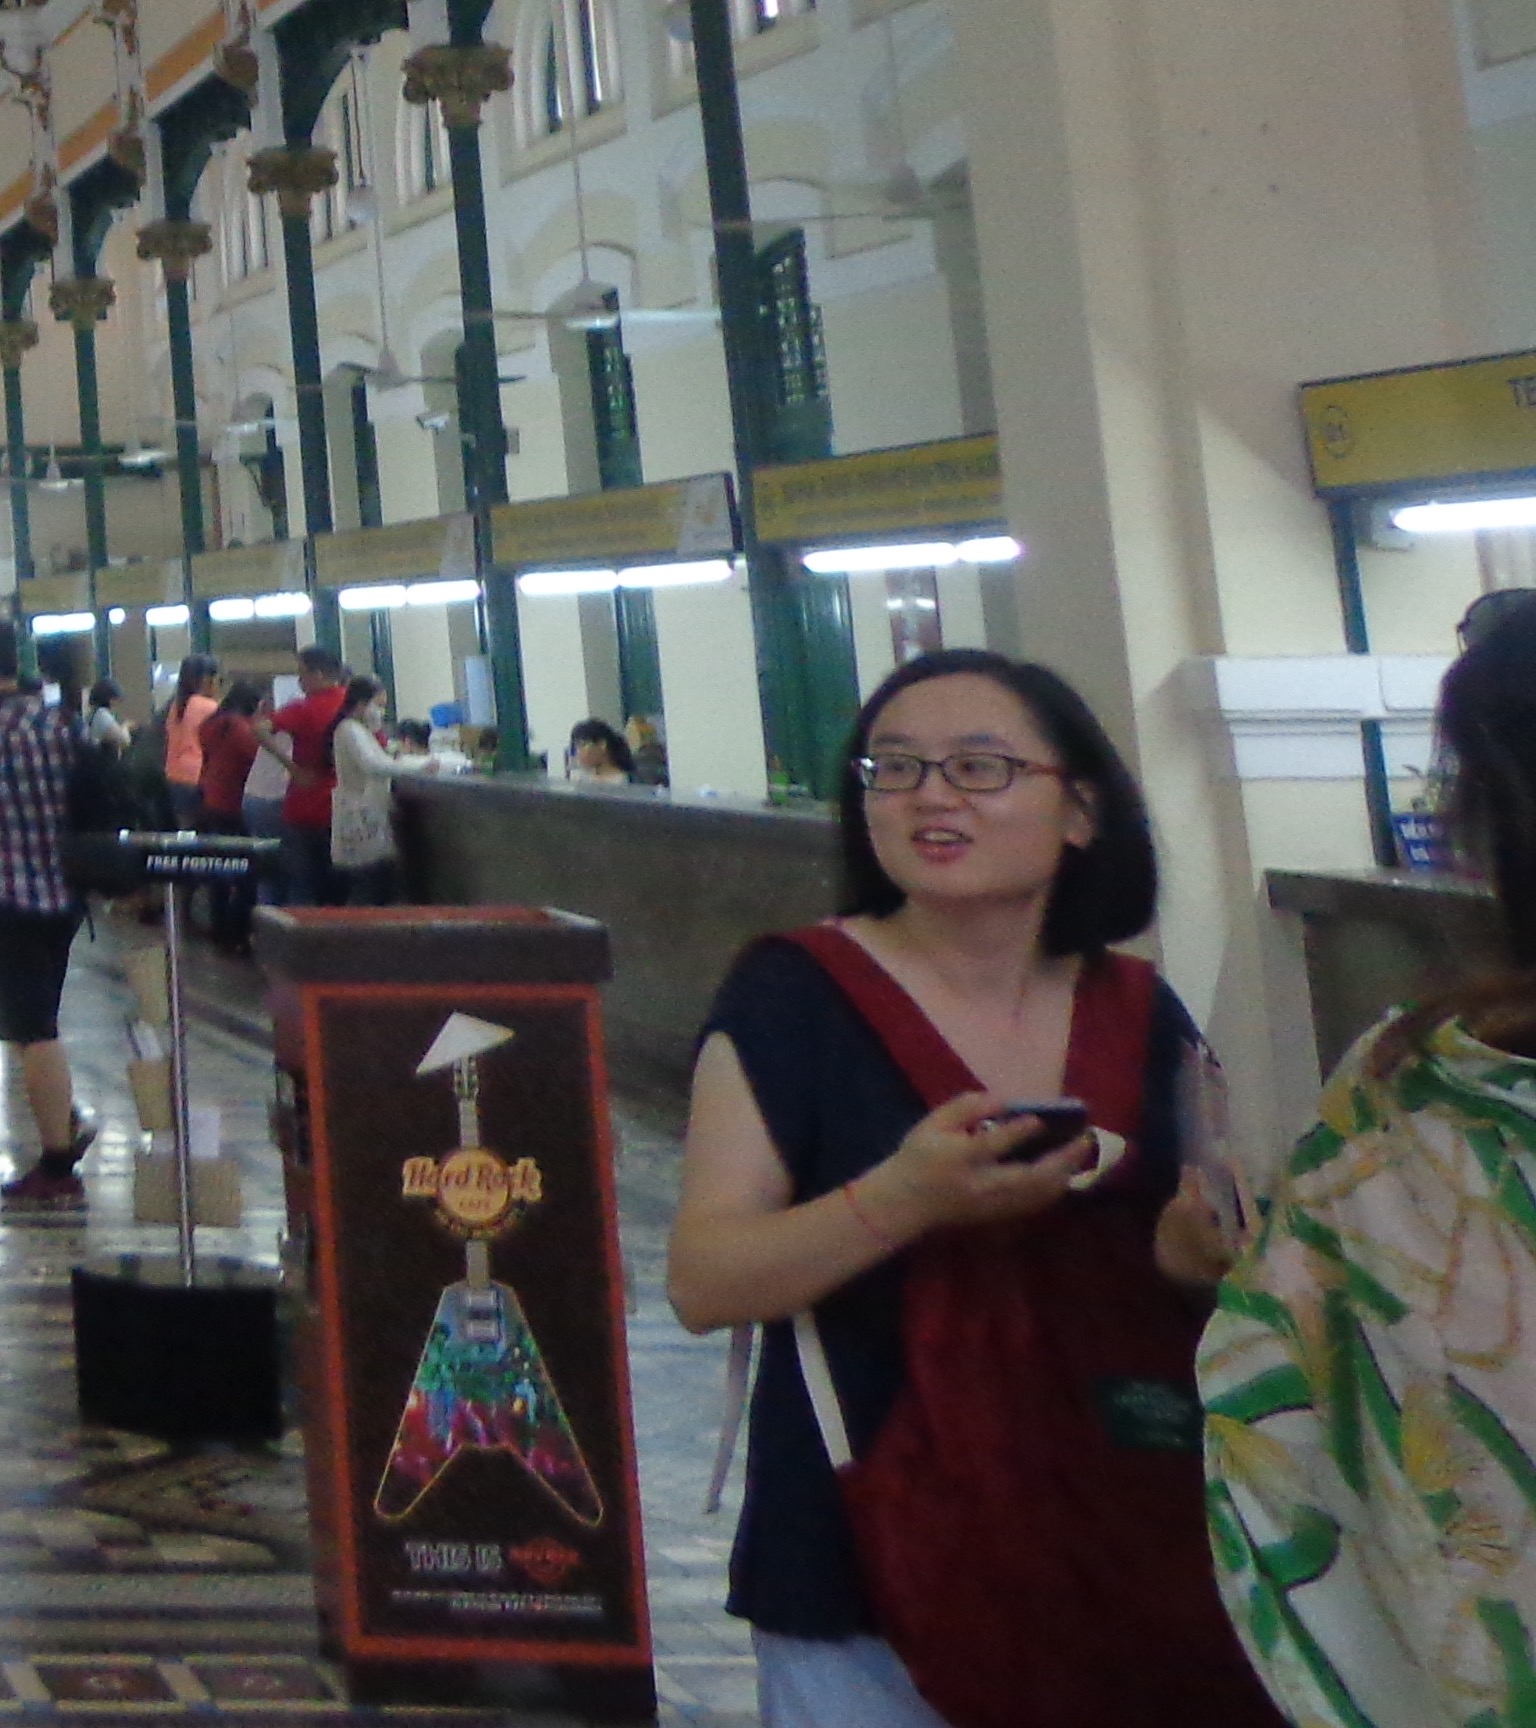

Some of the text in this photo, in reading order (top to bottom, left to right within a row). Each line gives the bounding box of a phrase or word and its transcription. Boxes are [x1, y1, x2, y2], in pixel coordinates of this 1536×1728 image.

[146, 855, 249, 874] FREE POSTCARD
[407, 1160, 540, 1195] Hard Rock
[404, 1539, 471, 1572] THIS
[474, 1541, 504, 1574] IS
